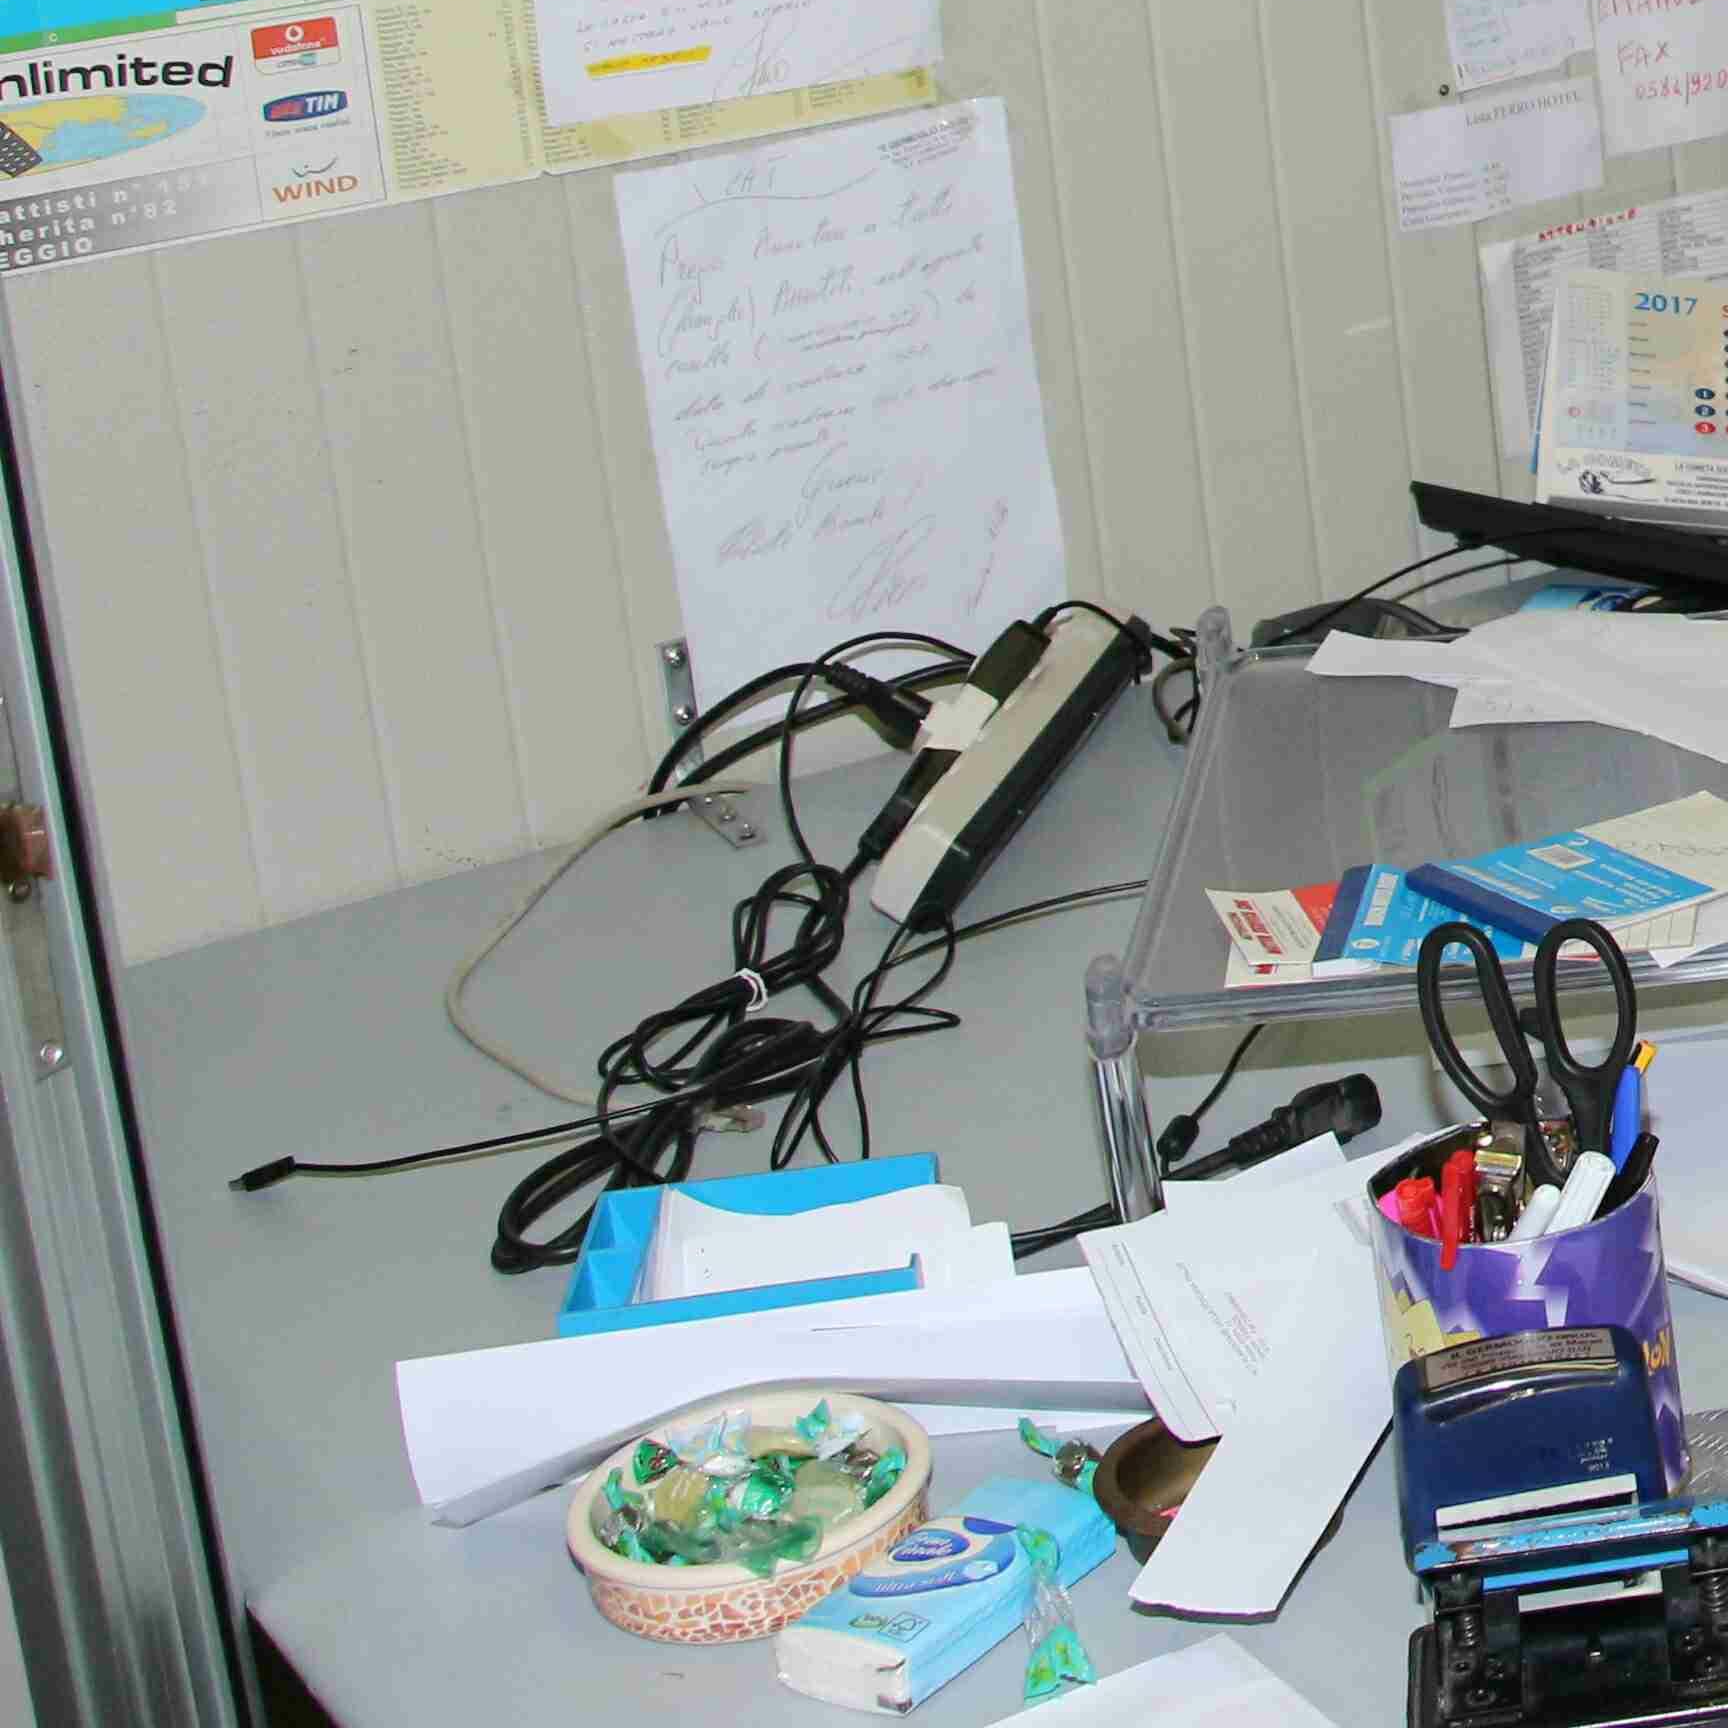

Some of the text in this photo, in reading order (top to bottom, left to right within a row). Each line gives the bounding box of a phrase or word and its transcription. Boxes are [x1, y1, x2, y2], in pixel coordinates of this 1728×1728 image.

[0, 53, 235, 101] nlimited
[304, 92, 340, 114] TIM
[272, 174, 359, 204] WIND
[1633, 292, 1699, 316] 2017
